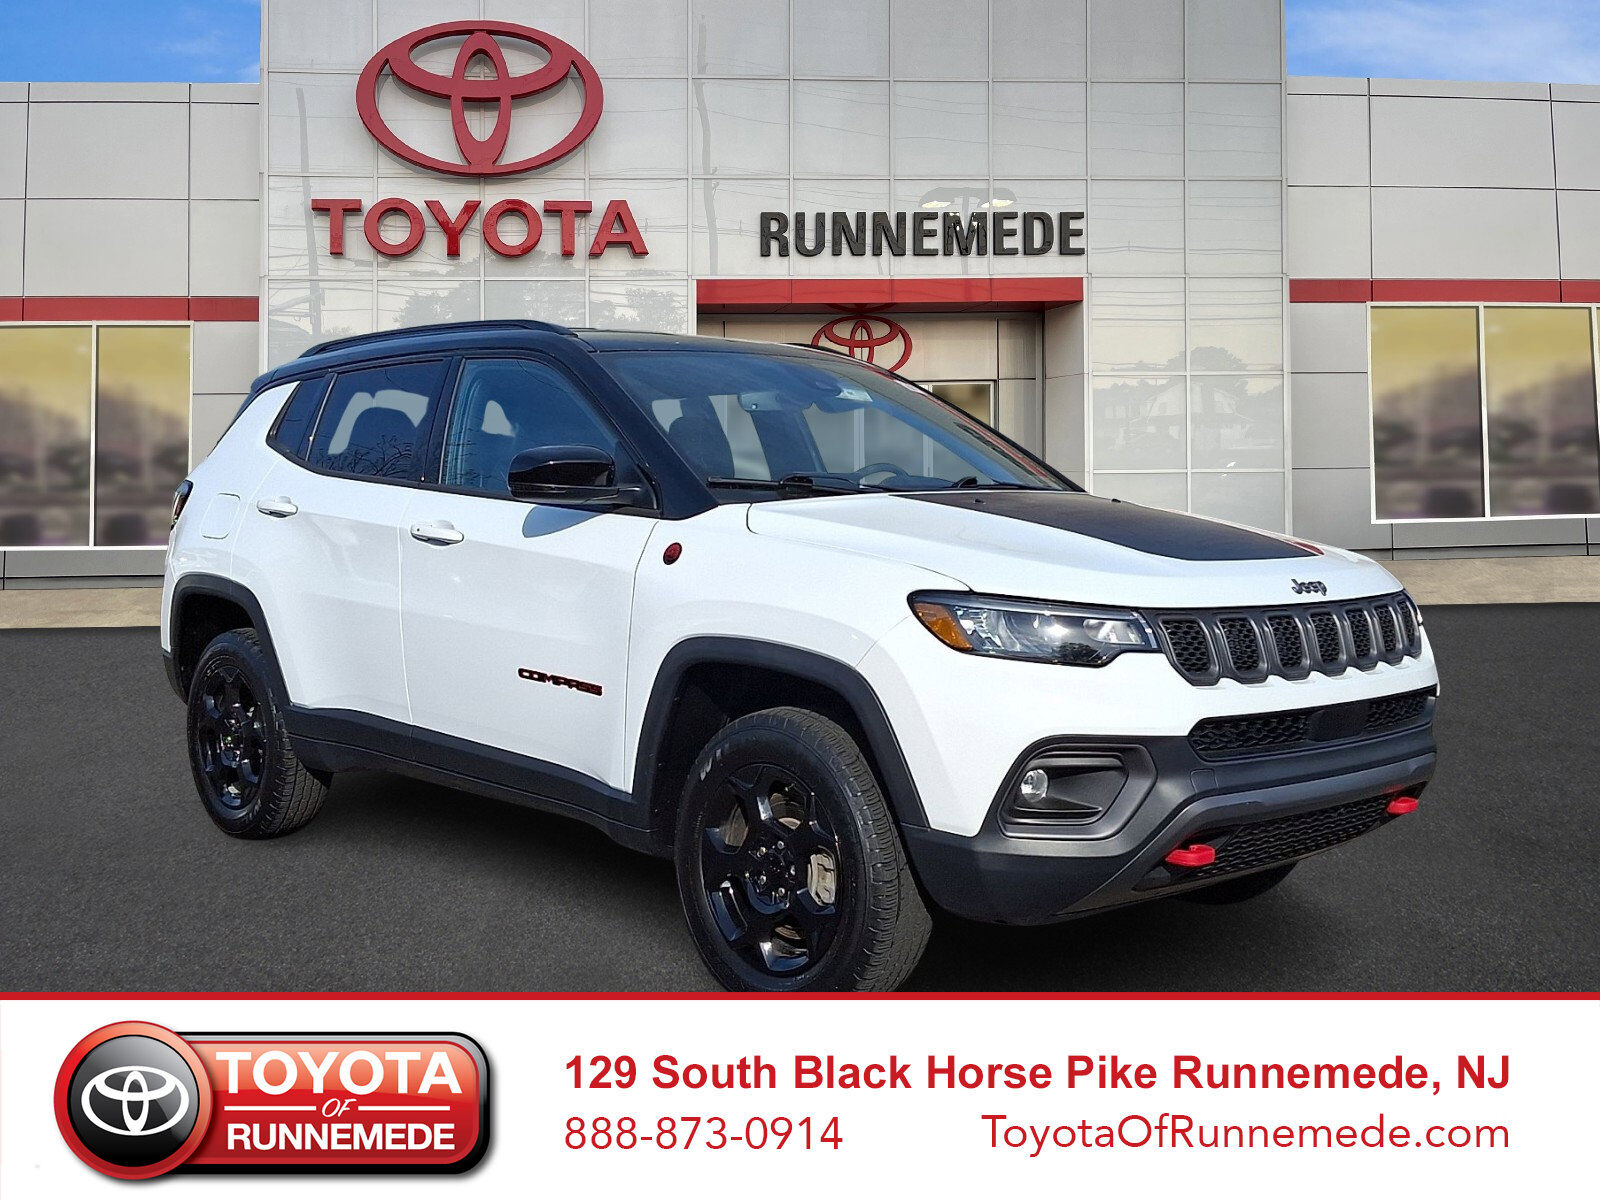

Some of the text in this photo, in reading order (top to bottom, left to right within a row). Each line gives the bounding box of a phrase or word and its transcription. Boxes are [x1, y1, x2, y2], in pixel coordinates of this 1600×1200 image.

[311, 197, 649, 258] TOYOTA
[760, 211, 1086, 258] RUNNEMEDE
[1291, 578, 1327, 597] Jeep
